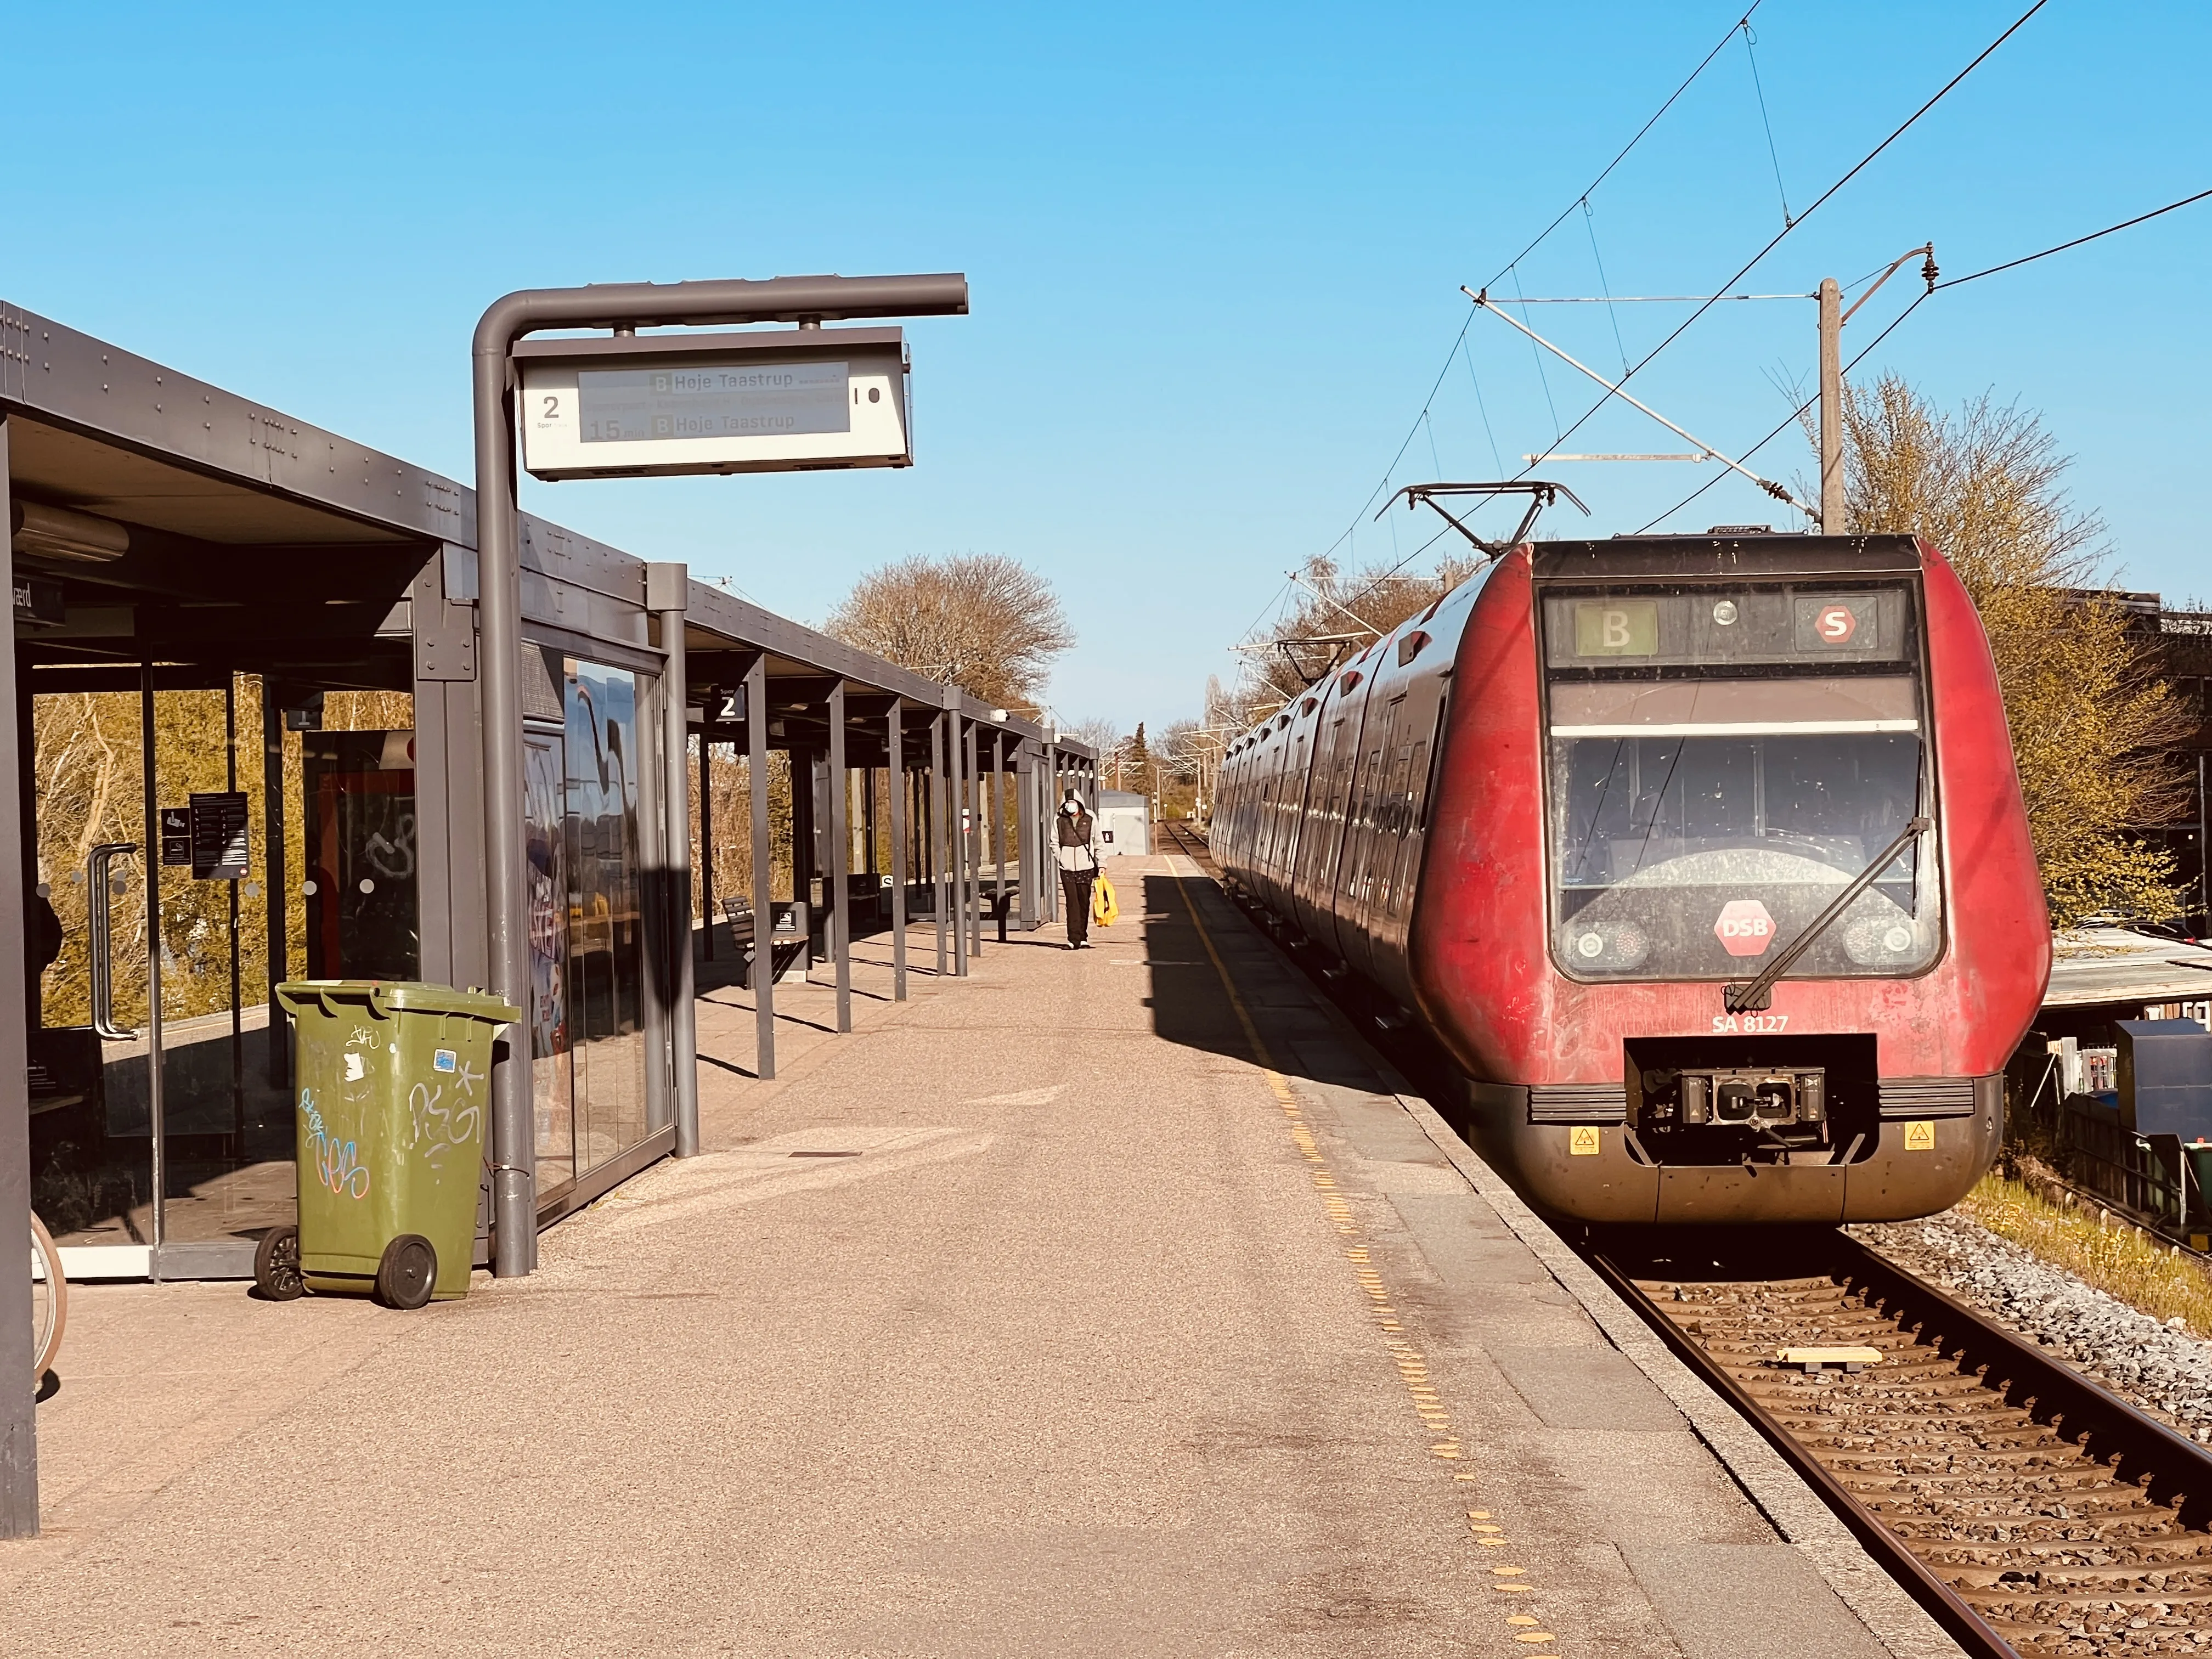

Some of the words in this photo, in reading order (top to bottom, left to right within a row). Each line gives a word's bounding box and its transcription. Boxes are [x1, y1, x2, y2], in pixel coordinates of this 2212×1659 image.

[656, 376, 667, 392] B
[675, 374, 711, 391] Høje
[719, 373, 793, 388] Taastrup
[544, 396, 559, 418] 2
[590, 420, 620, 439] 15
[624, 427, 645, 438] min
[657, 418, 668, 433] B
[676, 416, 713, 433] Høje
[720, 415, 794, 431] Taastrup
[1603, 611, 1629, 647] B
[1825, 612, 1847, 636] S
[720, 697, 735, 716] 2
[1722, 919, 1768, 937] DSB
[1712, 1016, 1739, 1033] SA
[1743, 1015, 1789, 1033] 8127
